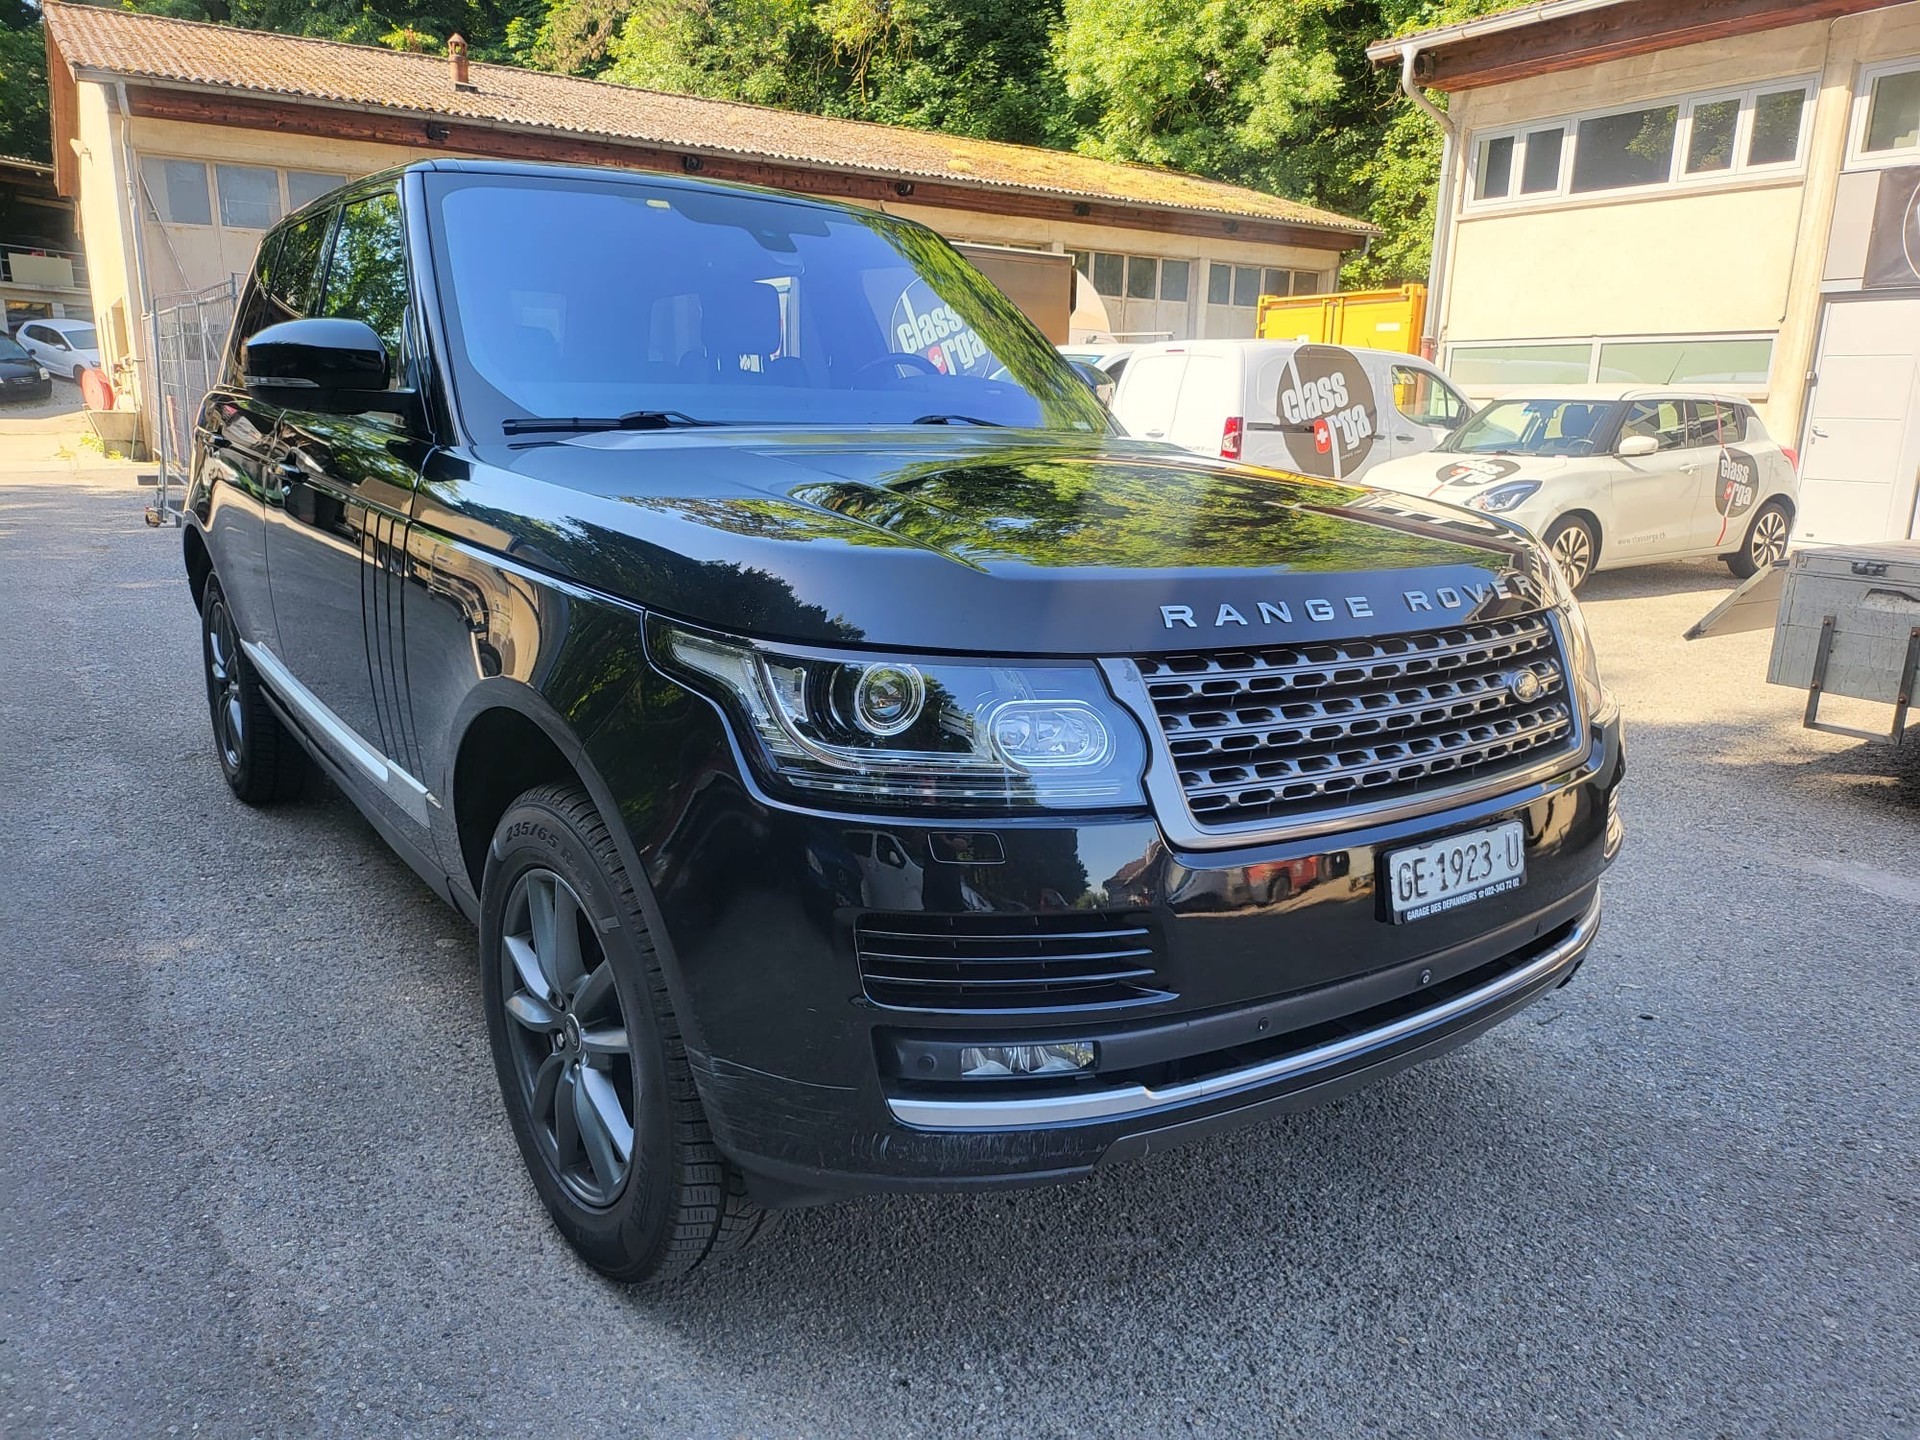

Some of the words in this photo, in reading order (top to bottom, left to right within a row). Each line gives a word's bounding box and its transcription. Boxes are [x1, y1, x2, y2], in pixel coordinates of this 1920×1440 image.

[896, 294, 963, 353] class
[1281, 360, 1349, 424] class
[1720, 453, 1750, 484] class
[1159, 595, 1374, 629] RANGE
[1403, 575, 1533, 613] ROVER
[506, 821, 559, 849] 235/65
[1406, 905, 1430, 921] GARAGE
[1430, 902, 1442, 914] DES
